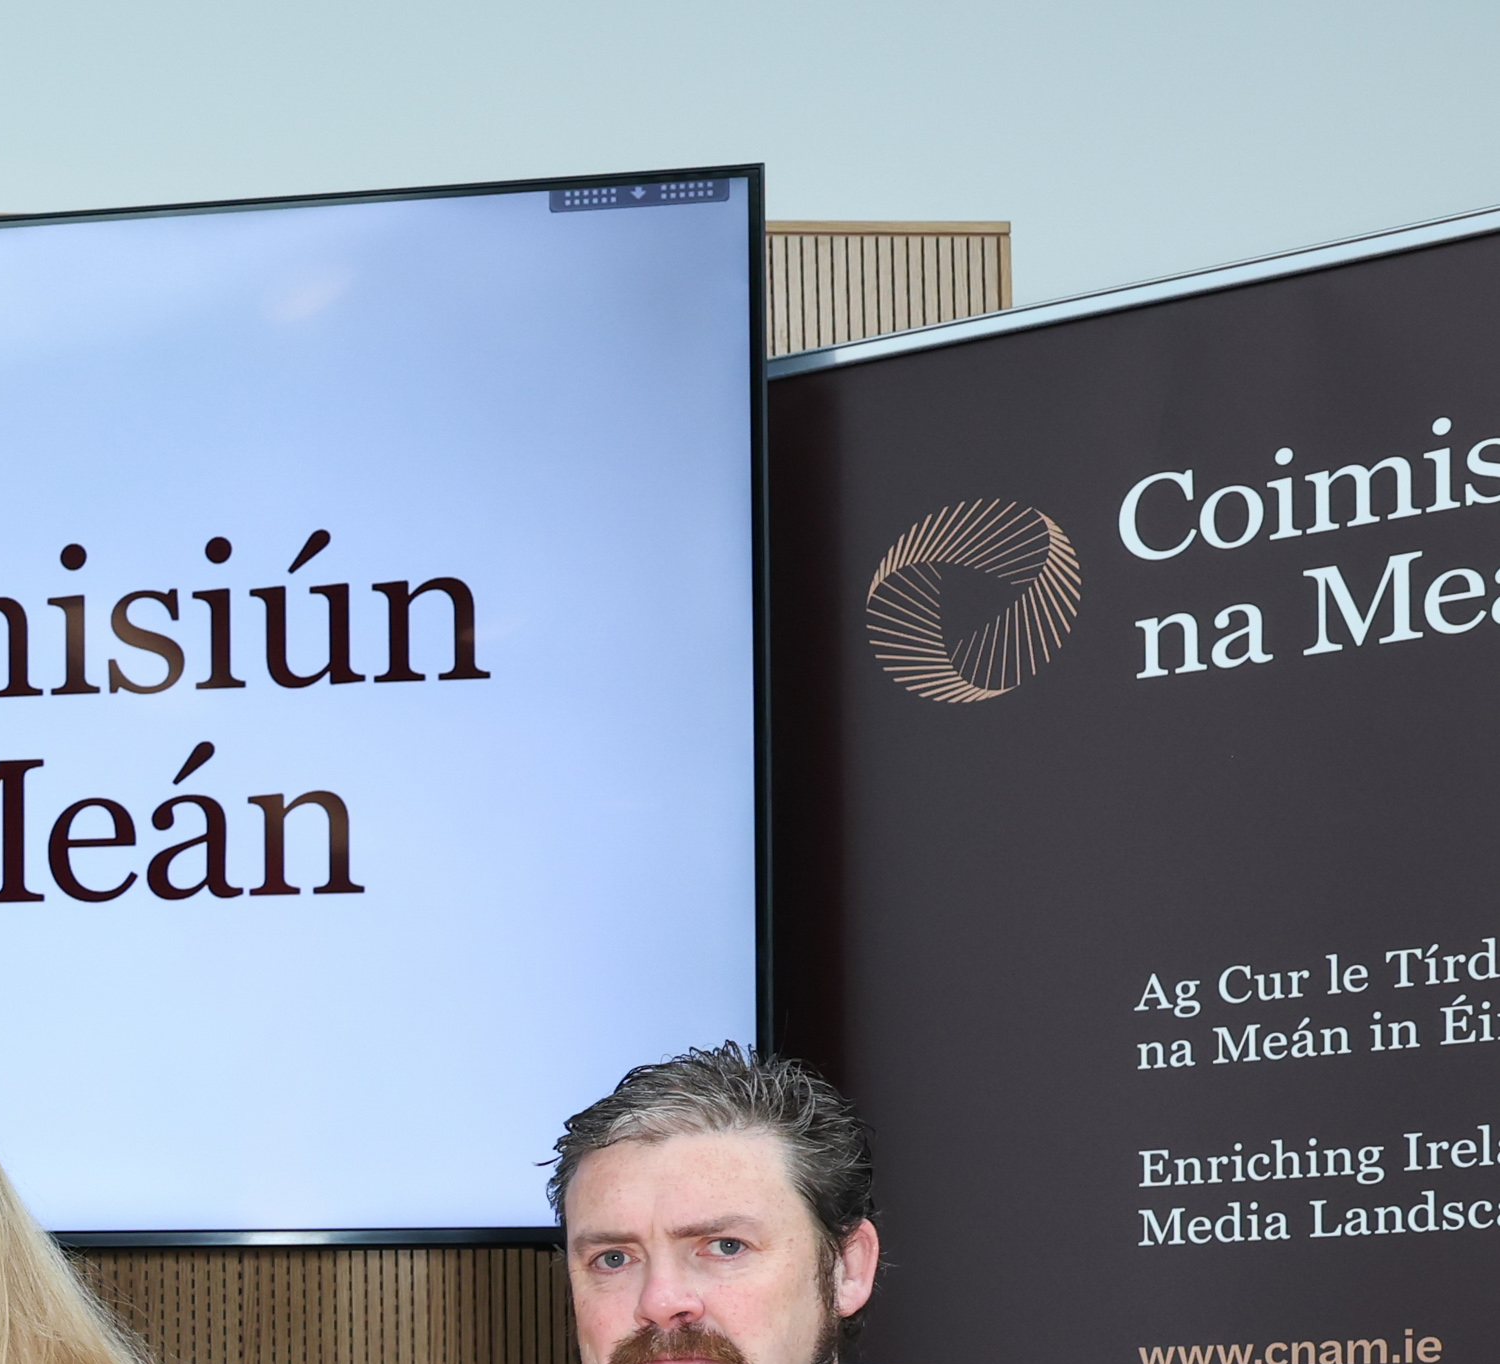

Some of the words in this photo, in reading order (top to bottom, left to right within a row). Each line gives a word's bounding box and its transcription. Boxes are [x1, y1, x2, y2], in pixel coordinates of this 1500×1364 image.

[1134, 603, 1274, 680] na
[1302, 550, 1500, 656] Me
[1133, 972, 1201, 1019] Ag
[1218, 964, 1310, 1004] Cur
[1325, 953, 1370, 995] le
[1136, 1039, 1196, 1070] na
[1212, 1016, 1353, 1065] Meán
[1369, 1011, 1421, 1052] in
[1439, 994, 1500, 1046] Éi
[1138, 1137, 1385, 1188] Enriching
[1403, 1124, 1500, 1172] Irel
[1137, 1201, 1291, 1247] Media
[1308, 1189, 1500, 1238] Landsc
